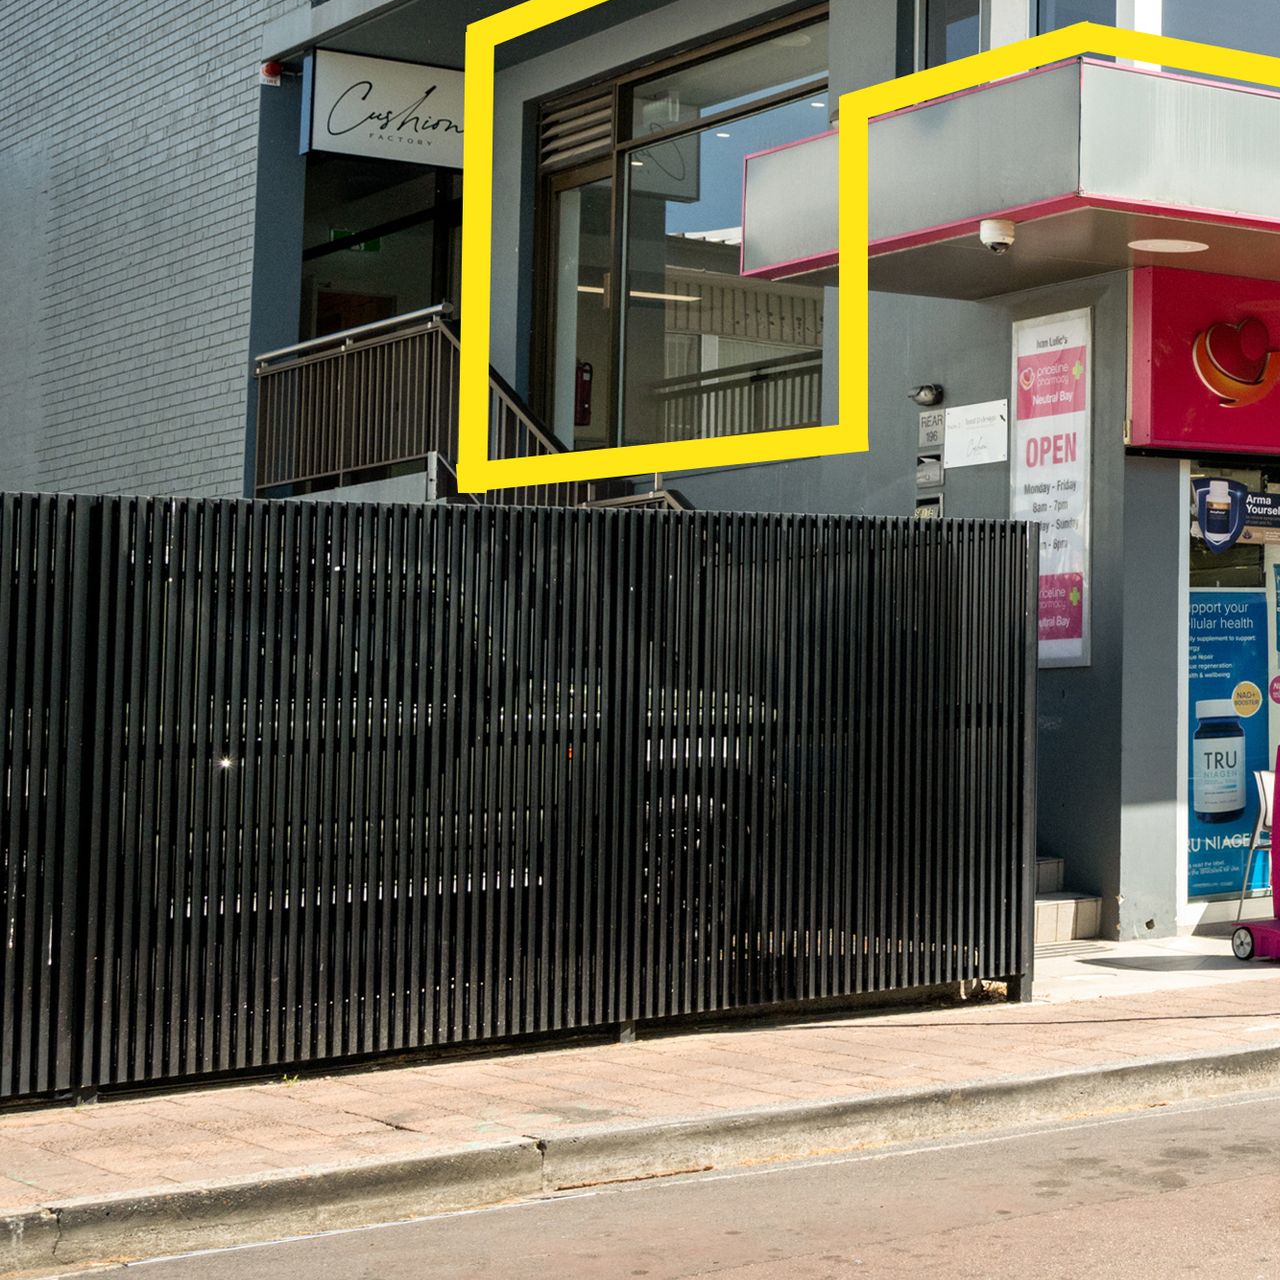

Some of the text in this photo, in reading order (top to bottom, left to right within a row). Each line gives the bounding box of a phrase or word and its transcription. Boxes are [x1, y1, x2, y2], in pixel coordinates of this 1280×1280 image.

[327, 80, 465, 136] Cushion
[369, 132, 433, 146] FACTORY
[1032, 390, 1073, 406] Neutral Bay
[921, 414, 943, 428] REAR
[1026, 432, 1077, 468] OPEN
[1024, 482, 1050, 495] Monday
[1057, 479, 1077, 492] Friday
[1246, 494, 1271, 505] Arma
[1039, 587, 1066, 599] riceline
[1224, 603, 1248, 616] your
[1056, 615, 1070, 627] Bay
[1220, 617, 1254, 629] health
[1204, 751, 1238, 770] TRU
[1205, 833, 1252, 851] NIAGE
